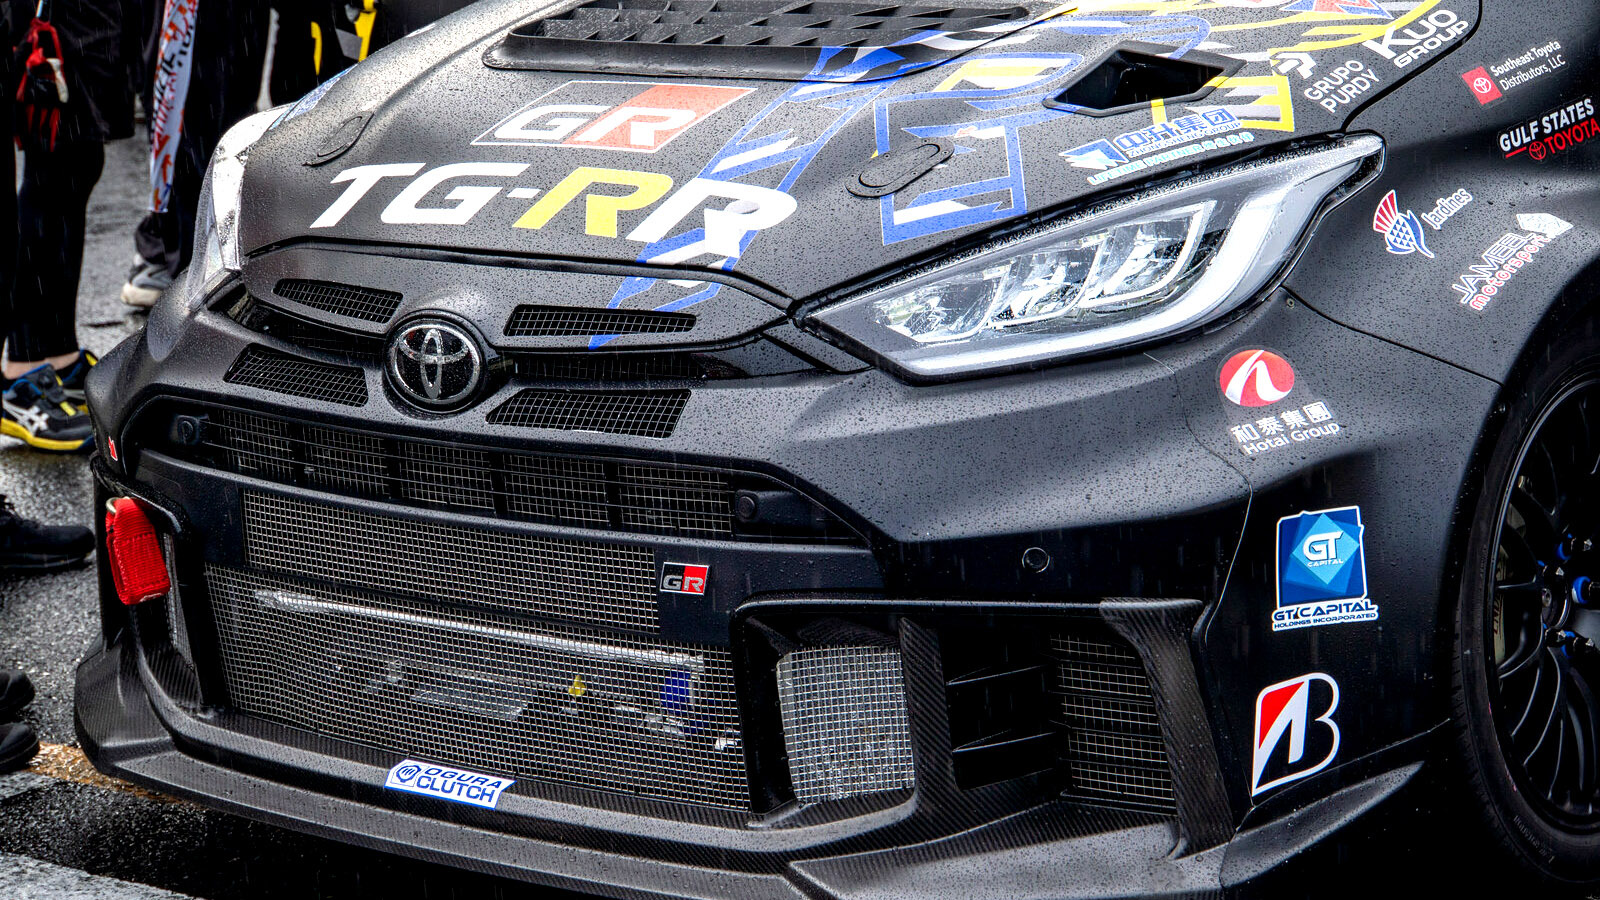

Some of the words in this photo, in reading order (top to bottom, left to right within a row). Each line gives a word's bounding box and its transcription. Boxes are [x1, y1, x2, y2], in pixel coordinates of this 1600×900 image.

[1363, 9, 1457, 60] KUO
[1394, 19, 1468, 68] GROUP
[1490, 51, 1533, 76] Southeast
[1534, 40, 1561, 59] Toyota
[1499, 62, 1551, 91] Distributors,
[1550, 54, 1566, 70] LLC
[1304, 60, 1364, 101] GRUPO
[1320, 69, 1380, 113] PURDY
[493, 104, 698, 148] GR
[1115, 108, 1236, 150] 中升集团
[1203, 122, 1242, 136] GROUP
[1499, 121, 1539, 152] GULF
[1541, 98, 1595, 134] STATES
[1544, 118, 1600, 154] TOYOTA
[1088, 159, 1145, 185] LIFETIME
[1146, 145, 1204, 166] PARTNER
[309, 162, 798, 257] TG-RR
[1421, 188, 1473, 230] Jardines
[1452, 232, 1536, 304] JAMEEL
[1470, 235, 1551, 311] motorsport
[1232, 401, 1333, 444] 和泰集團
[1242, 433, 1290, 456] Hotai
[1290, 423, 1340, 442] Group
[1302, 531, 1344, 562] GT
[1307, 558, 1344, 568] CAPITAL
[662, 574, 705, 594] GR
[1274, 618, 1312, 630] HOLDINGS
[1313, 612, 1377, 625] INCORPORATED
[1298, 600, 1377, 618] CAPITAL
[417, 775, 495, 803] CLUTCH
[424, 767, 501, 789] OGURA
